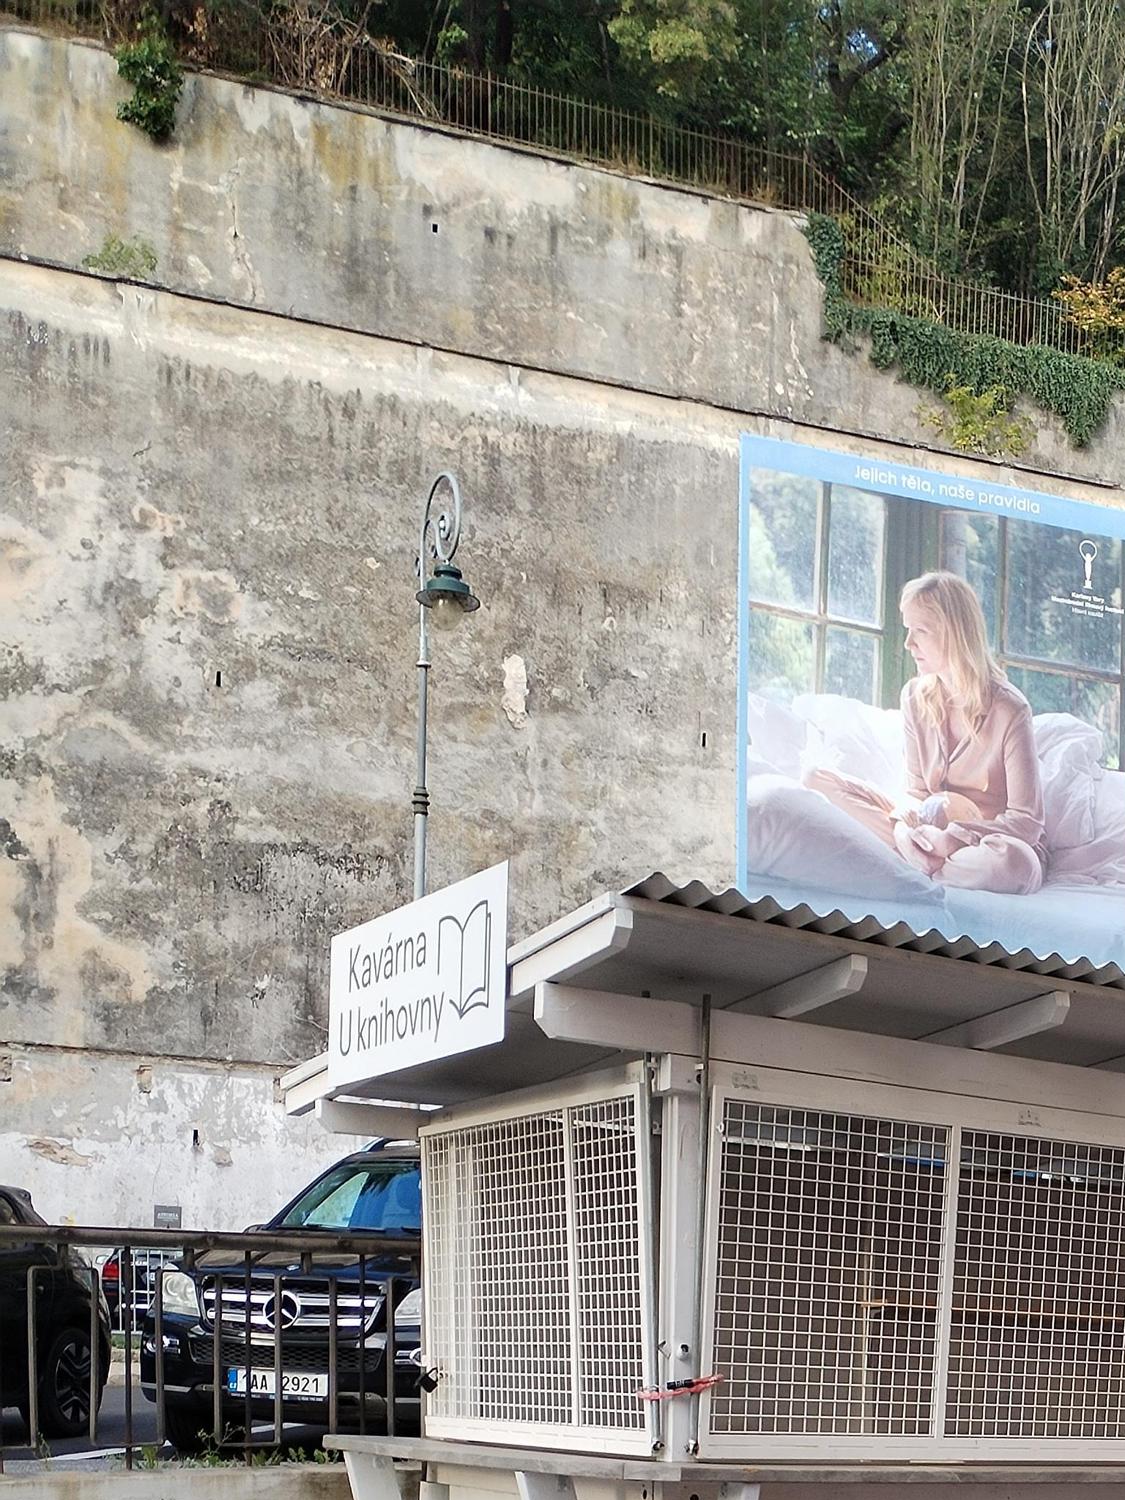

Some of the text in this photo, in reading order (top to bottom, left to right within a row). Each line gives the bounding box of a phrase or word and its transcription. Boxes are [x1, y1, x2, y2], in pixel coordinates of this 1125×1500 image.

[855, 466, 1040, 514] Jejich těla, naše pravidla
[349, 932, 427, 993] Kavárna
[339, 992, 445, 1057] U knihovny
[281, 1376, 320, 1393] 2921
